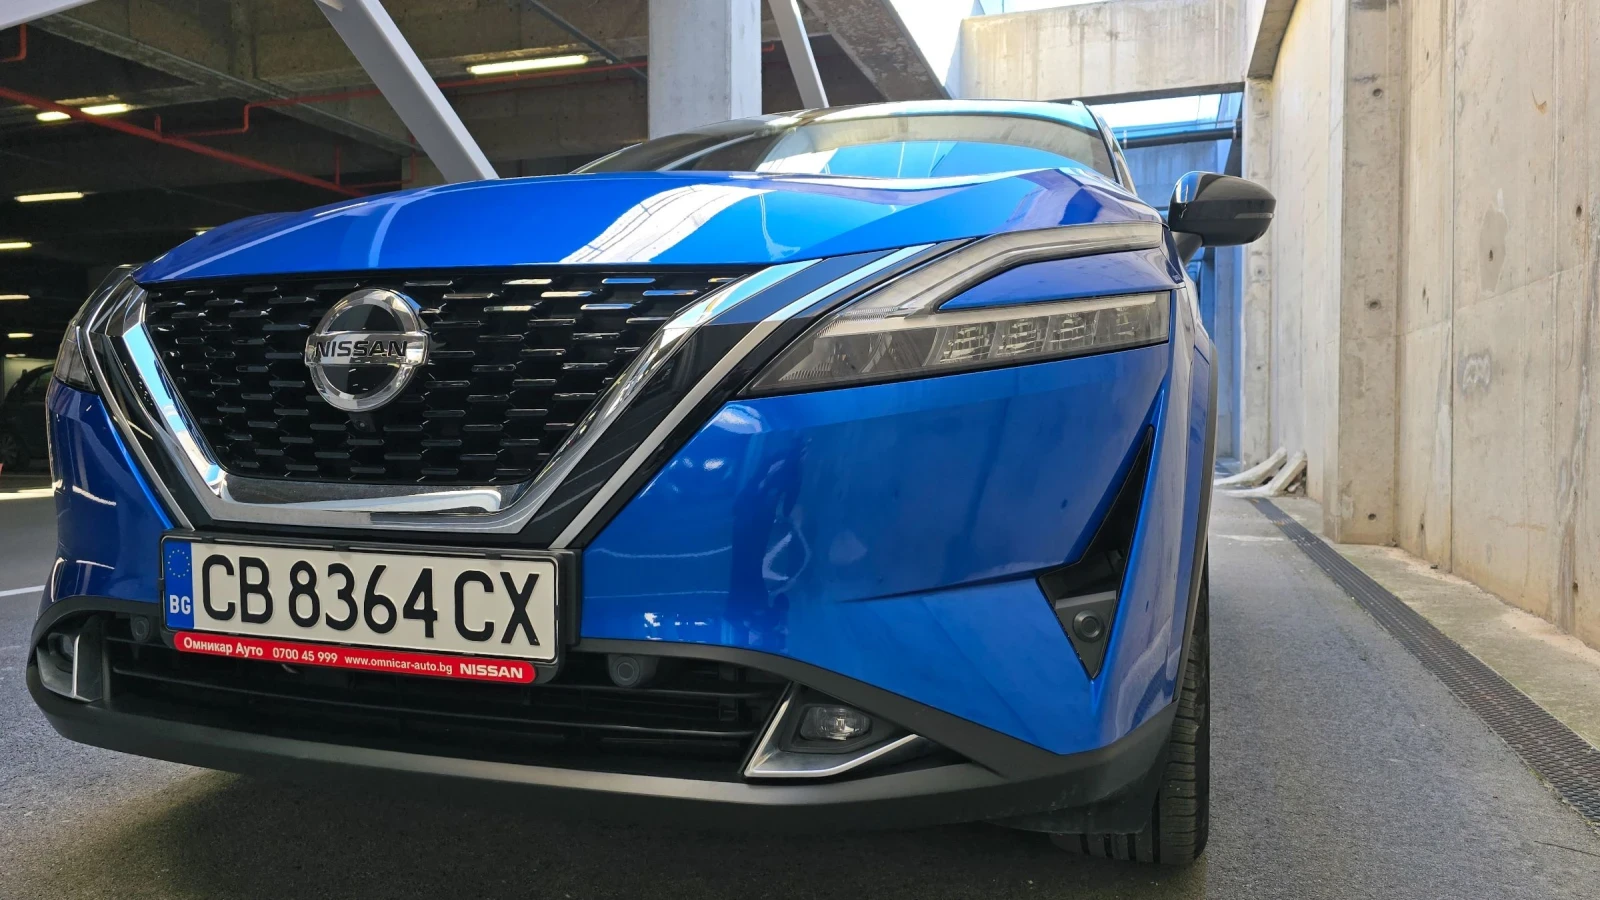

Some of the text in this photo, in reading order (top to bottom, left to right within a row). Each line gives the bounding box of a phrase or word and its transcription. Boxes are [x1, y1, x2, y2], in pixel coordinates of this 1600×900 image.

[315, 340, 408, 358] NISSAN
[169, 594, 192, 616] BG
[201, 554, 541, 647] CB 8364 CX
[183, 636, 523, 679] Омникар Ауто 0700 45 999 www.omnicar-auto.bg NISSAN
